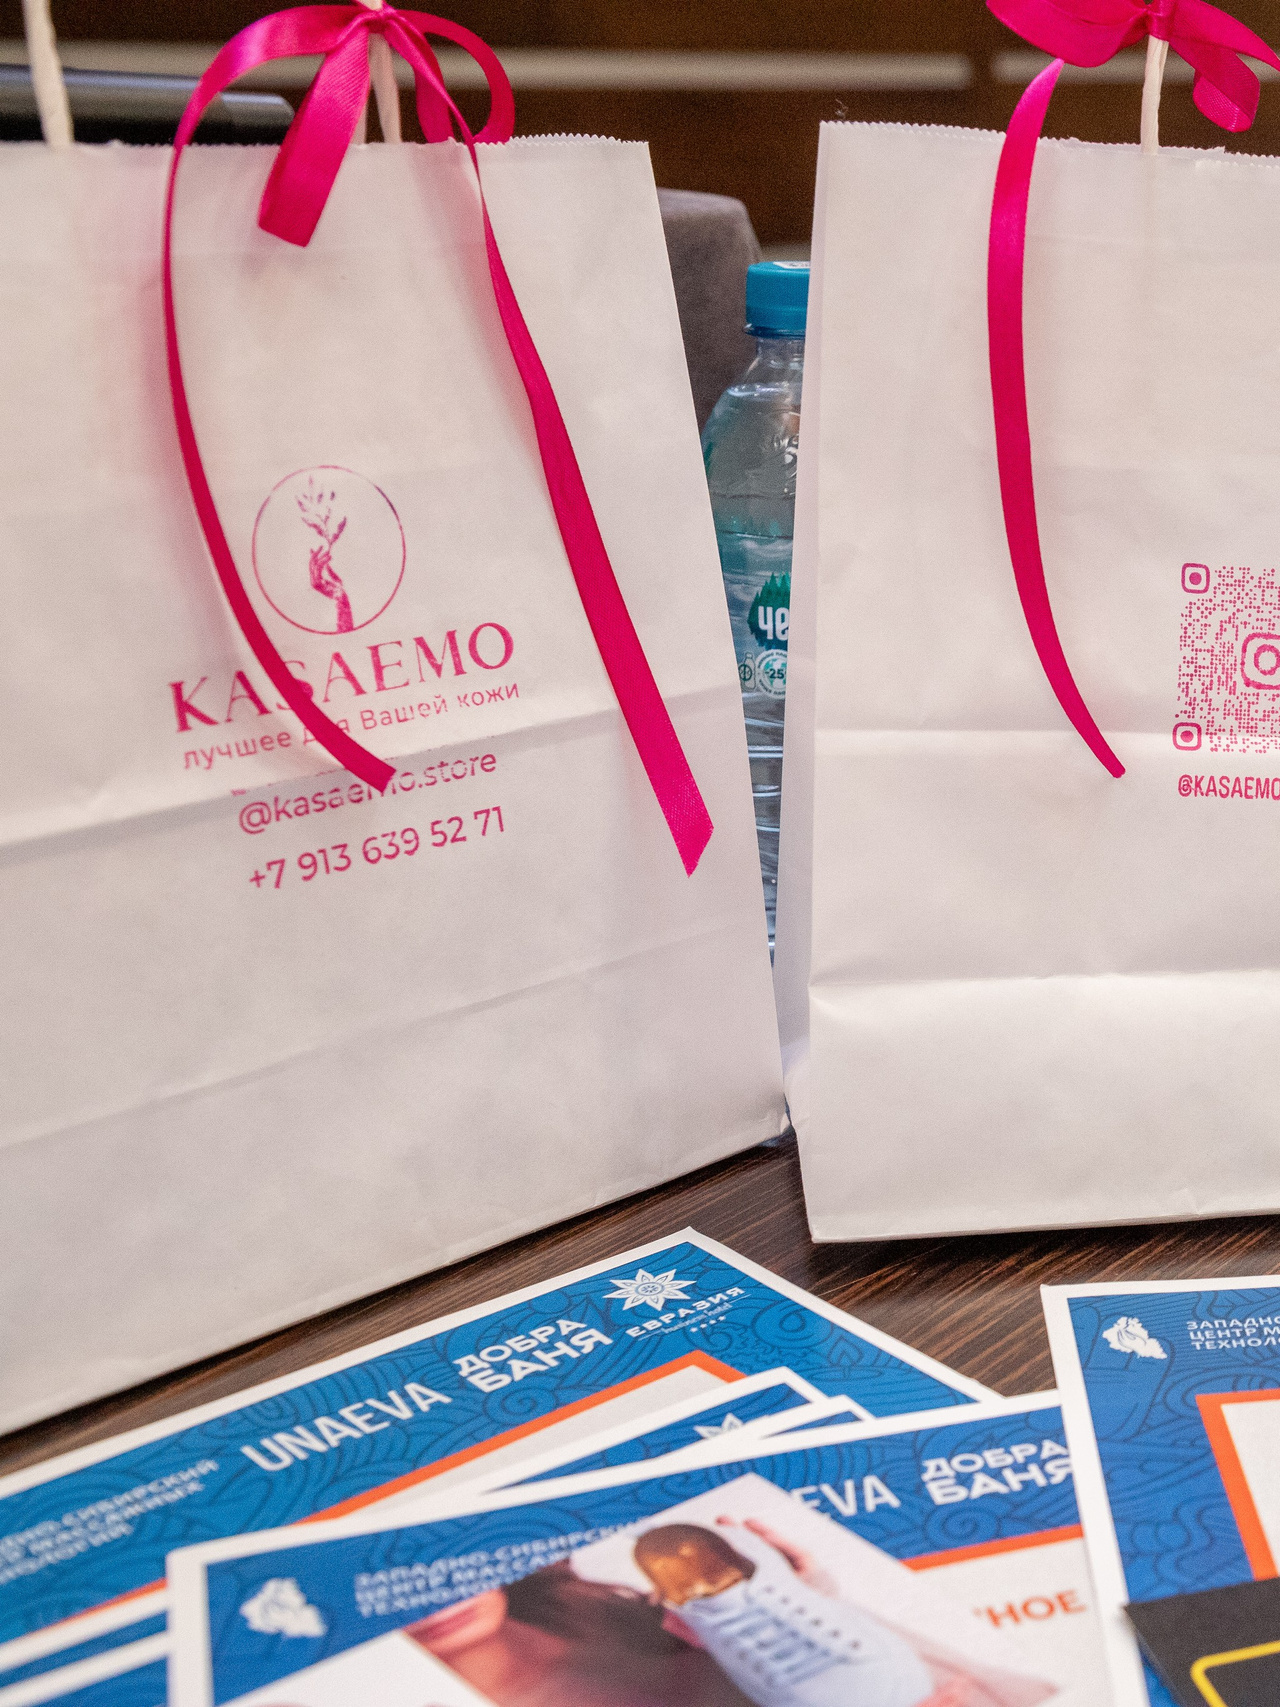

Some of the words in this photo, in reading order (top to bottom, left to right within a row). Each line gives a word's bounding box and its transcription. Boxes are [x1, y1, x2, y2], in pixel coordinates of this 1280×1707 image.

[167, 622, 514, 732] KASAEMO
[183, 729, 293, 771] лучшее
[302, 717, 350, 745] дя
[360, 691, 449, 731] Вашей
[457, 681, 521, 709] кожи
[249, 859, 286, 889] +7
[297, 843, 352, 882] 913
[362, 827, 421, 864] 639
[430, 816, 467, 848] 52
[473, 805, 505, 837] 71
[625, 1286, 745, 1338] ЕВРАЗИЯ
[1189, 1327, 1257, 1341] ЦЕНТР
[452, 1317, 587, 1378] ДОБРА
[466, 1327, 614, 1393] БАНЯ
[240, 1381, 453, 1472] UNAEVA
[921, 1438, 1071, 1482] ДОБРА
[926, 1457, 1075, 1505] БАНЯ
[789, 1474, 901, 1517] EVA
[972, 1589, 1087, 1628] НОЕ
